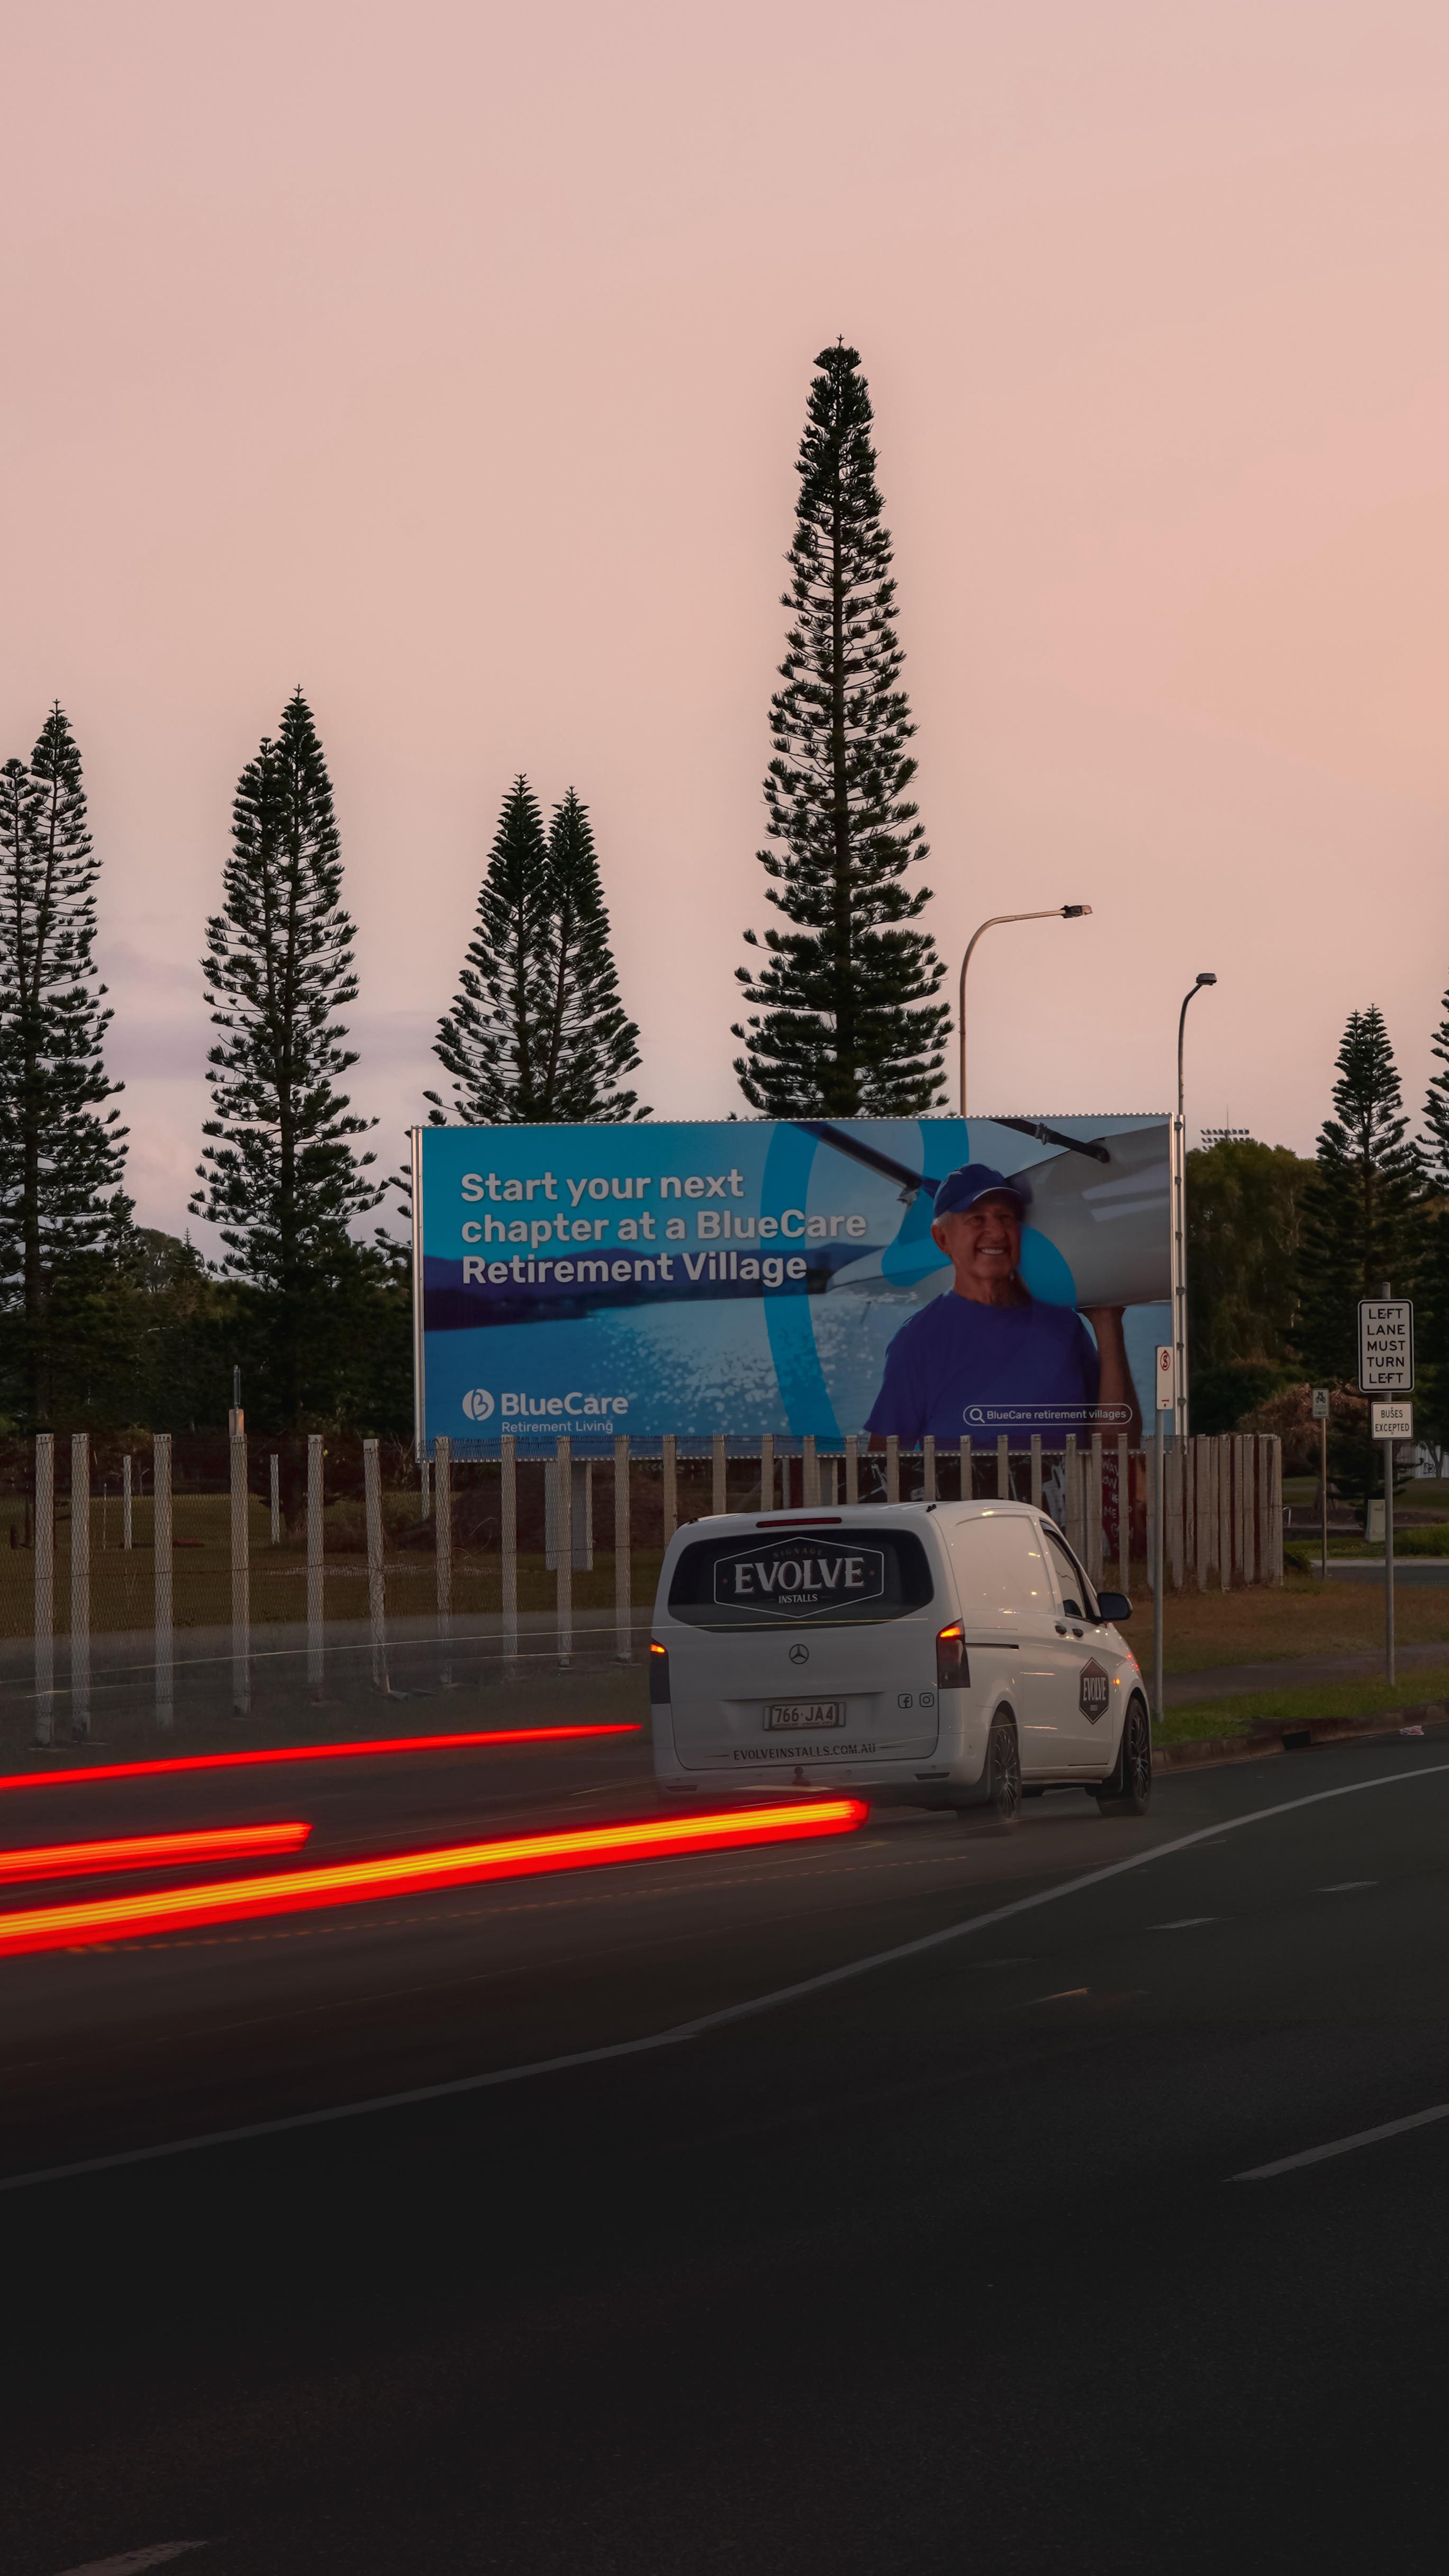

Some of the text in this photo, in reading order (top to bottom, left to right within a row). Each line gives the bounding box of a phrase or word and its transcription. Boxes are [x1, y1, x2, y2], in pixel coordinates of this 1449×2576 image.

[461, 1168, 744, 1206] Start your next
[461, 1209, 866, 1249] chapter at a BlueCare
[463, 1251, 807, 1287] Retirement Village
[1369, 1309, 1402, 1319] LEFT
[1367, 1325, 1406, 1335] LANE
[1367, 1340, 1406, 1351] MUST
[1366, 1357, 1405, 1367] TURN
[1369, 1373, 1403, 1383] LEFT
[501, 1392, 628, 1416] BlueCare
[987, 1409, 1126, 1420] BlueCare retirement villages
[502, 1421, 613, 1434] Retirement Living
[1375, 1423, 1409, 1431] EXCEPTED
[773, 1547, 823, 1559] SIGNAGE
[734, 1557, 864, 1595] EVOLVE
[779, 1594, 818, 1604] INSTALLS
[1083, 1677, 1106, 1701] EVOLVE
[733, 1743, 876, 1760] EVOLVEINSTALLS.COM.AU
